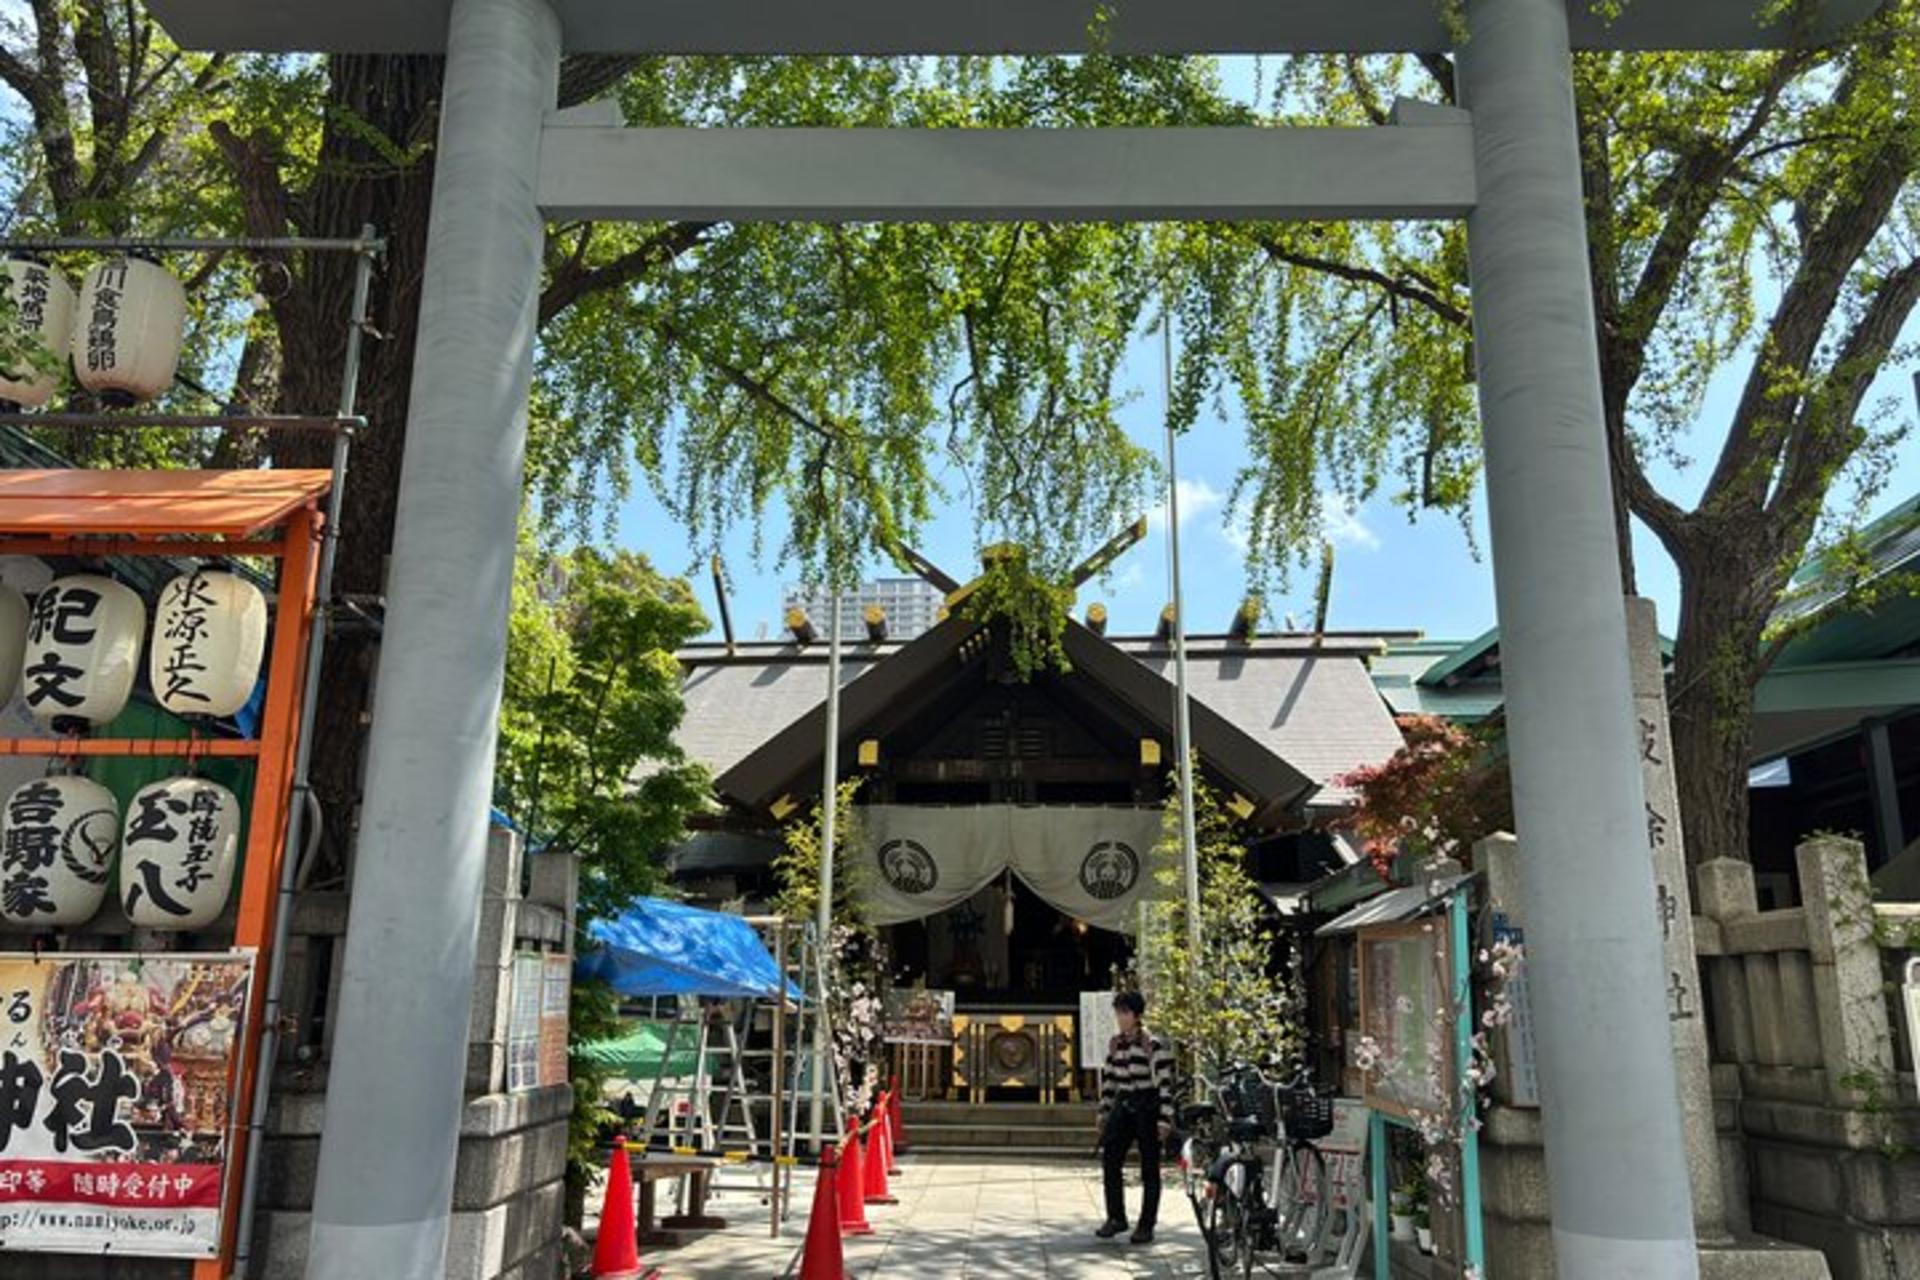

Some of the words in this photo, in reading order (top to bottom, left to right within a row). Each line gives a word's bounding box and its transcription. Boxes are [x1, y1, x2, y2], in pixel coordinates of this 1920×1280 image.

[26, 586, 103, 707] 紀文
[2, 781, 64, 918] 吉野家
[125, 789, 192, 917] 玉八
[8, 990, 31, 1023] る
[73, 1172, 194, 1199] 随時受付中
